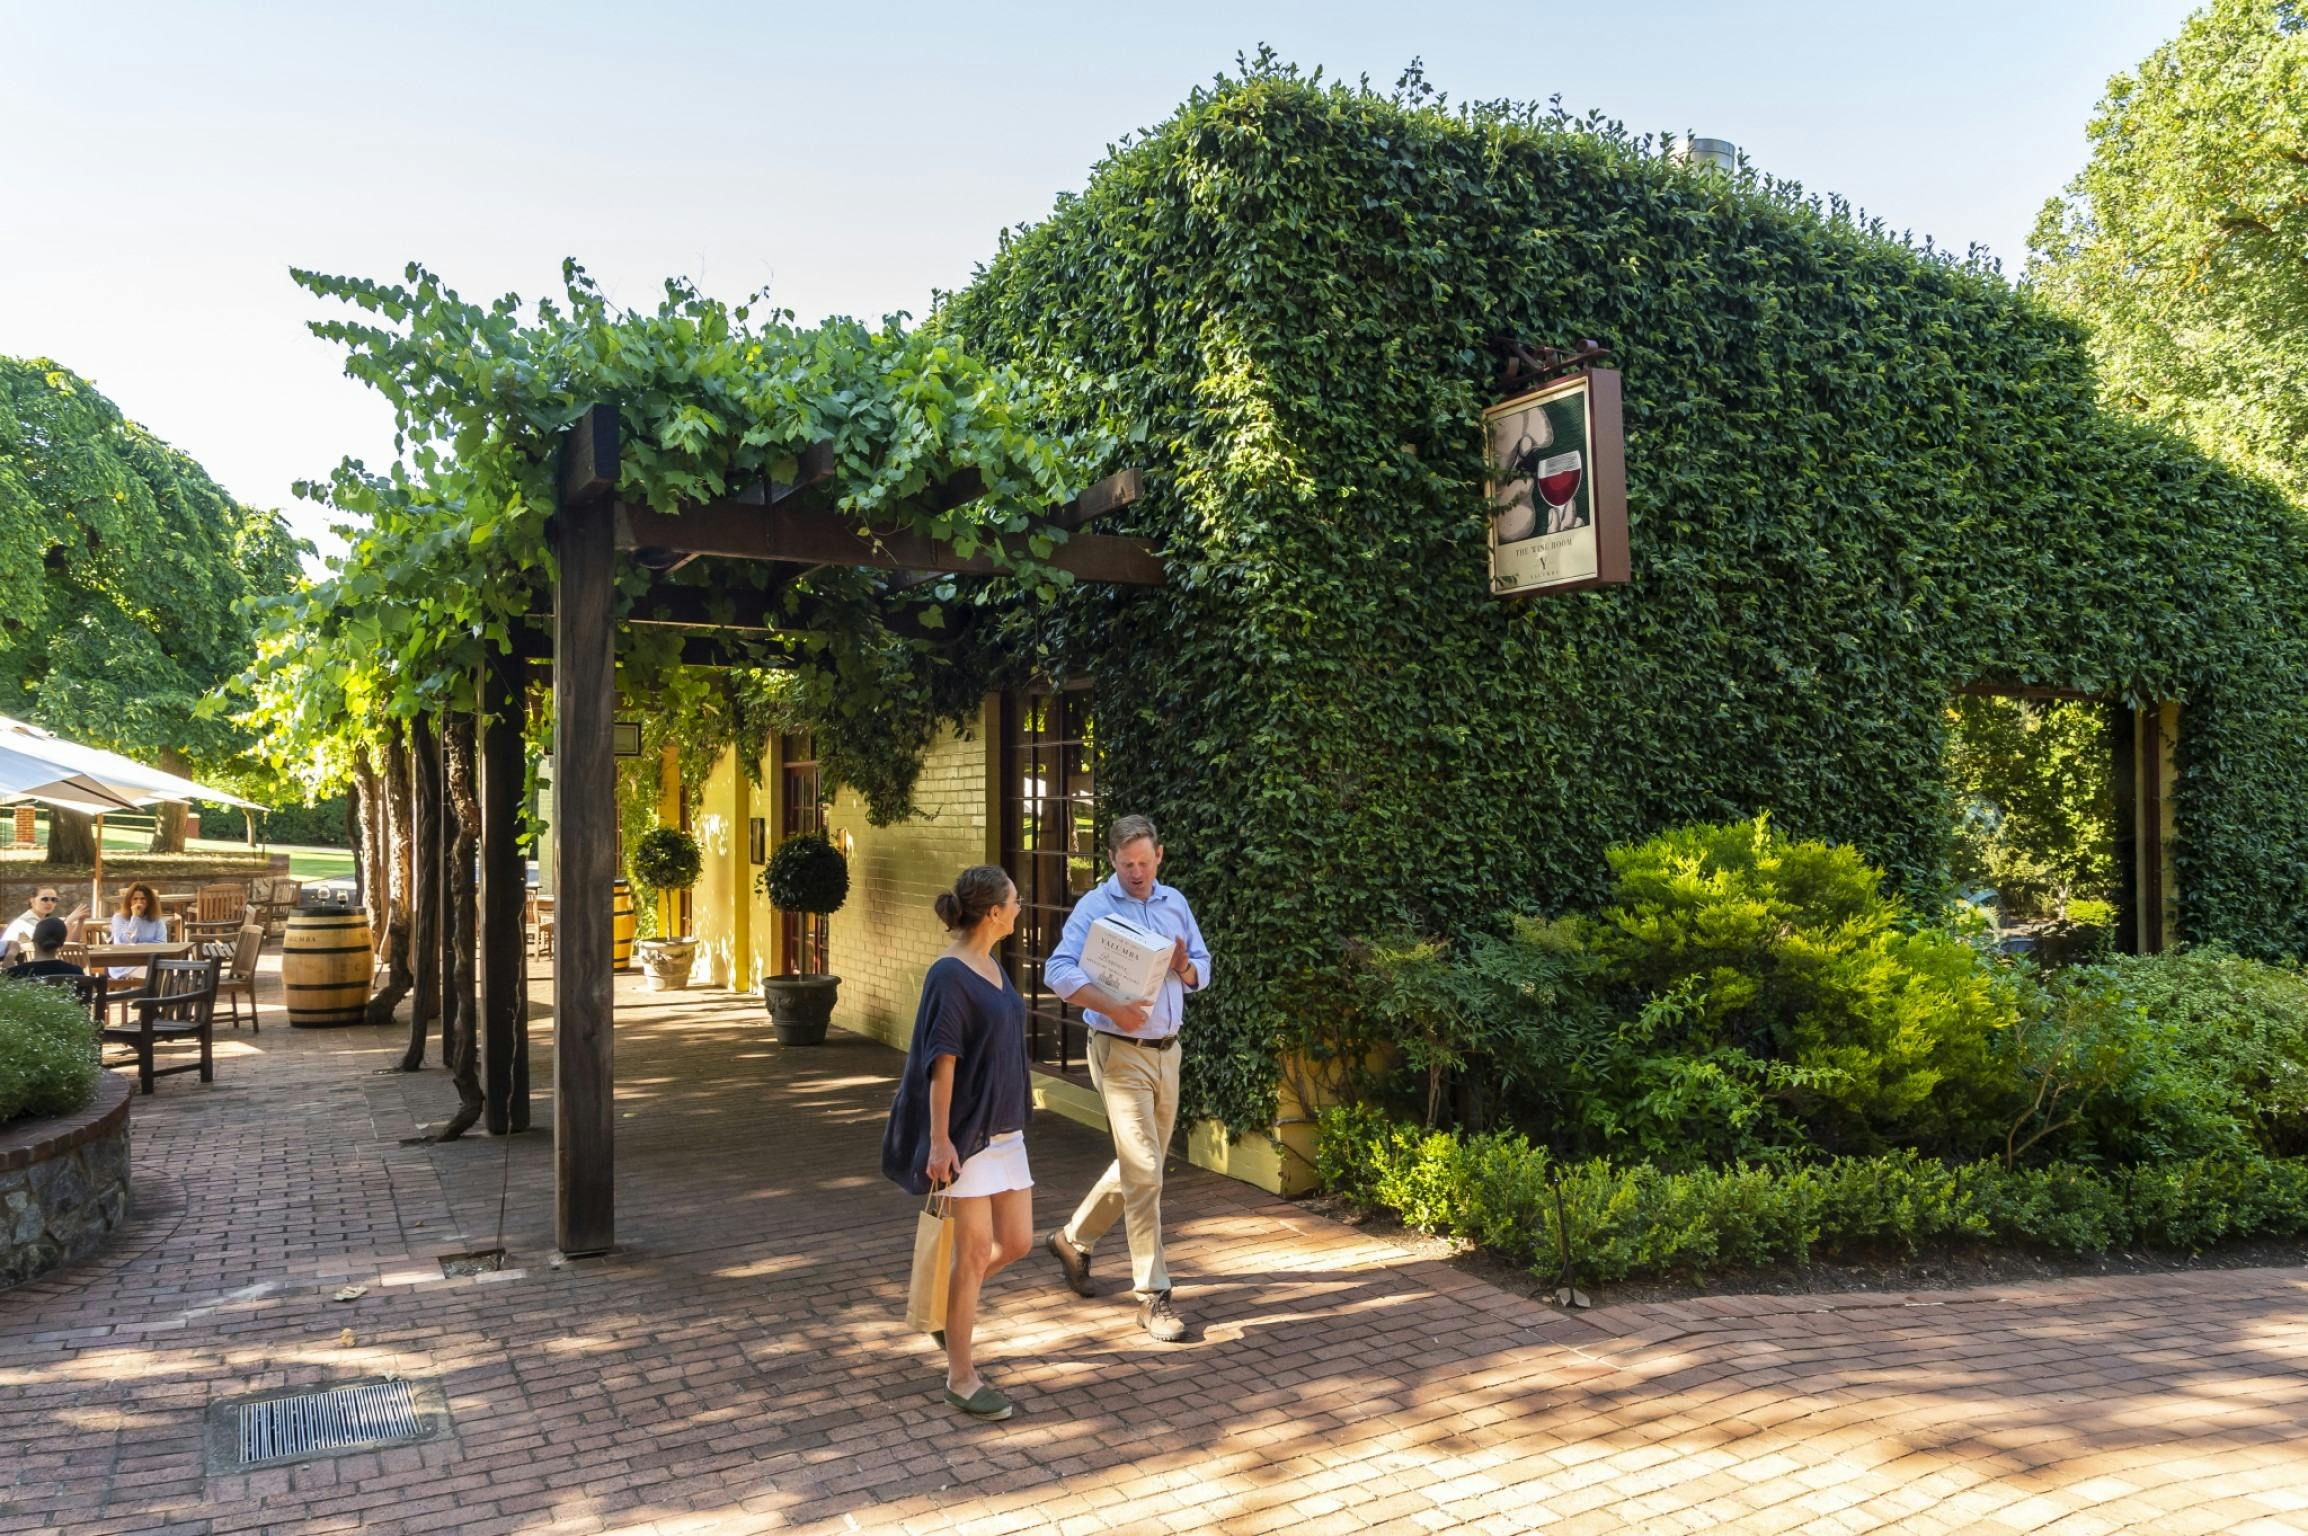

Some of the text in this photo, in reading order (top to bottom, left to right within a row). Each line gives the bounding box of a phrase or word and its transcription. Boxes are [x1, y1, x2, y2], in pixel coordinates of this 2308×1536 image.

[1515, 537, 1572, 556] THE WINE ROOM
[1539, 556, 1547, 569] Y
